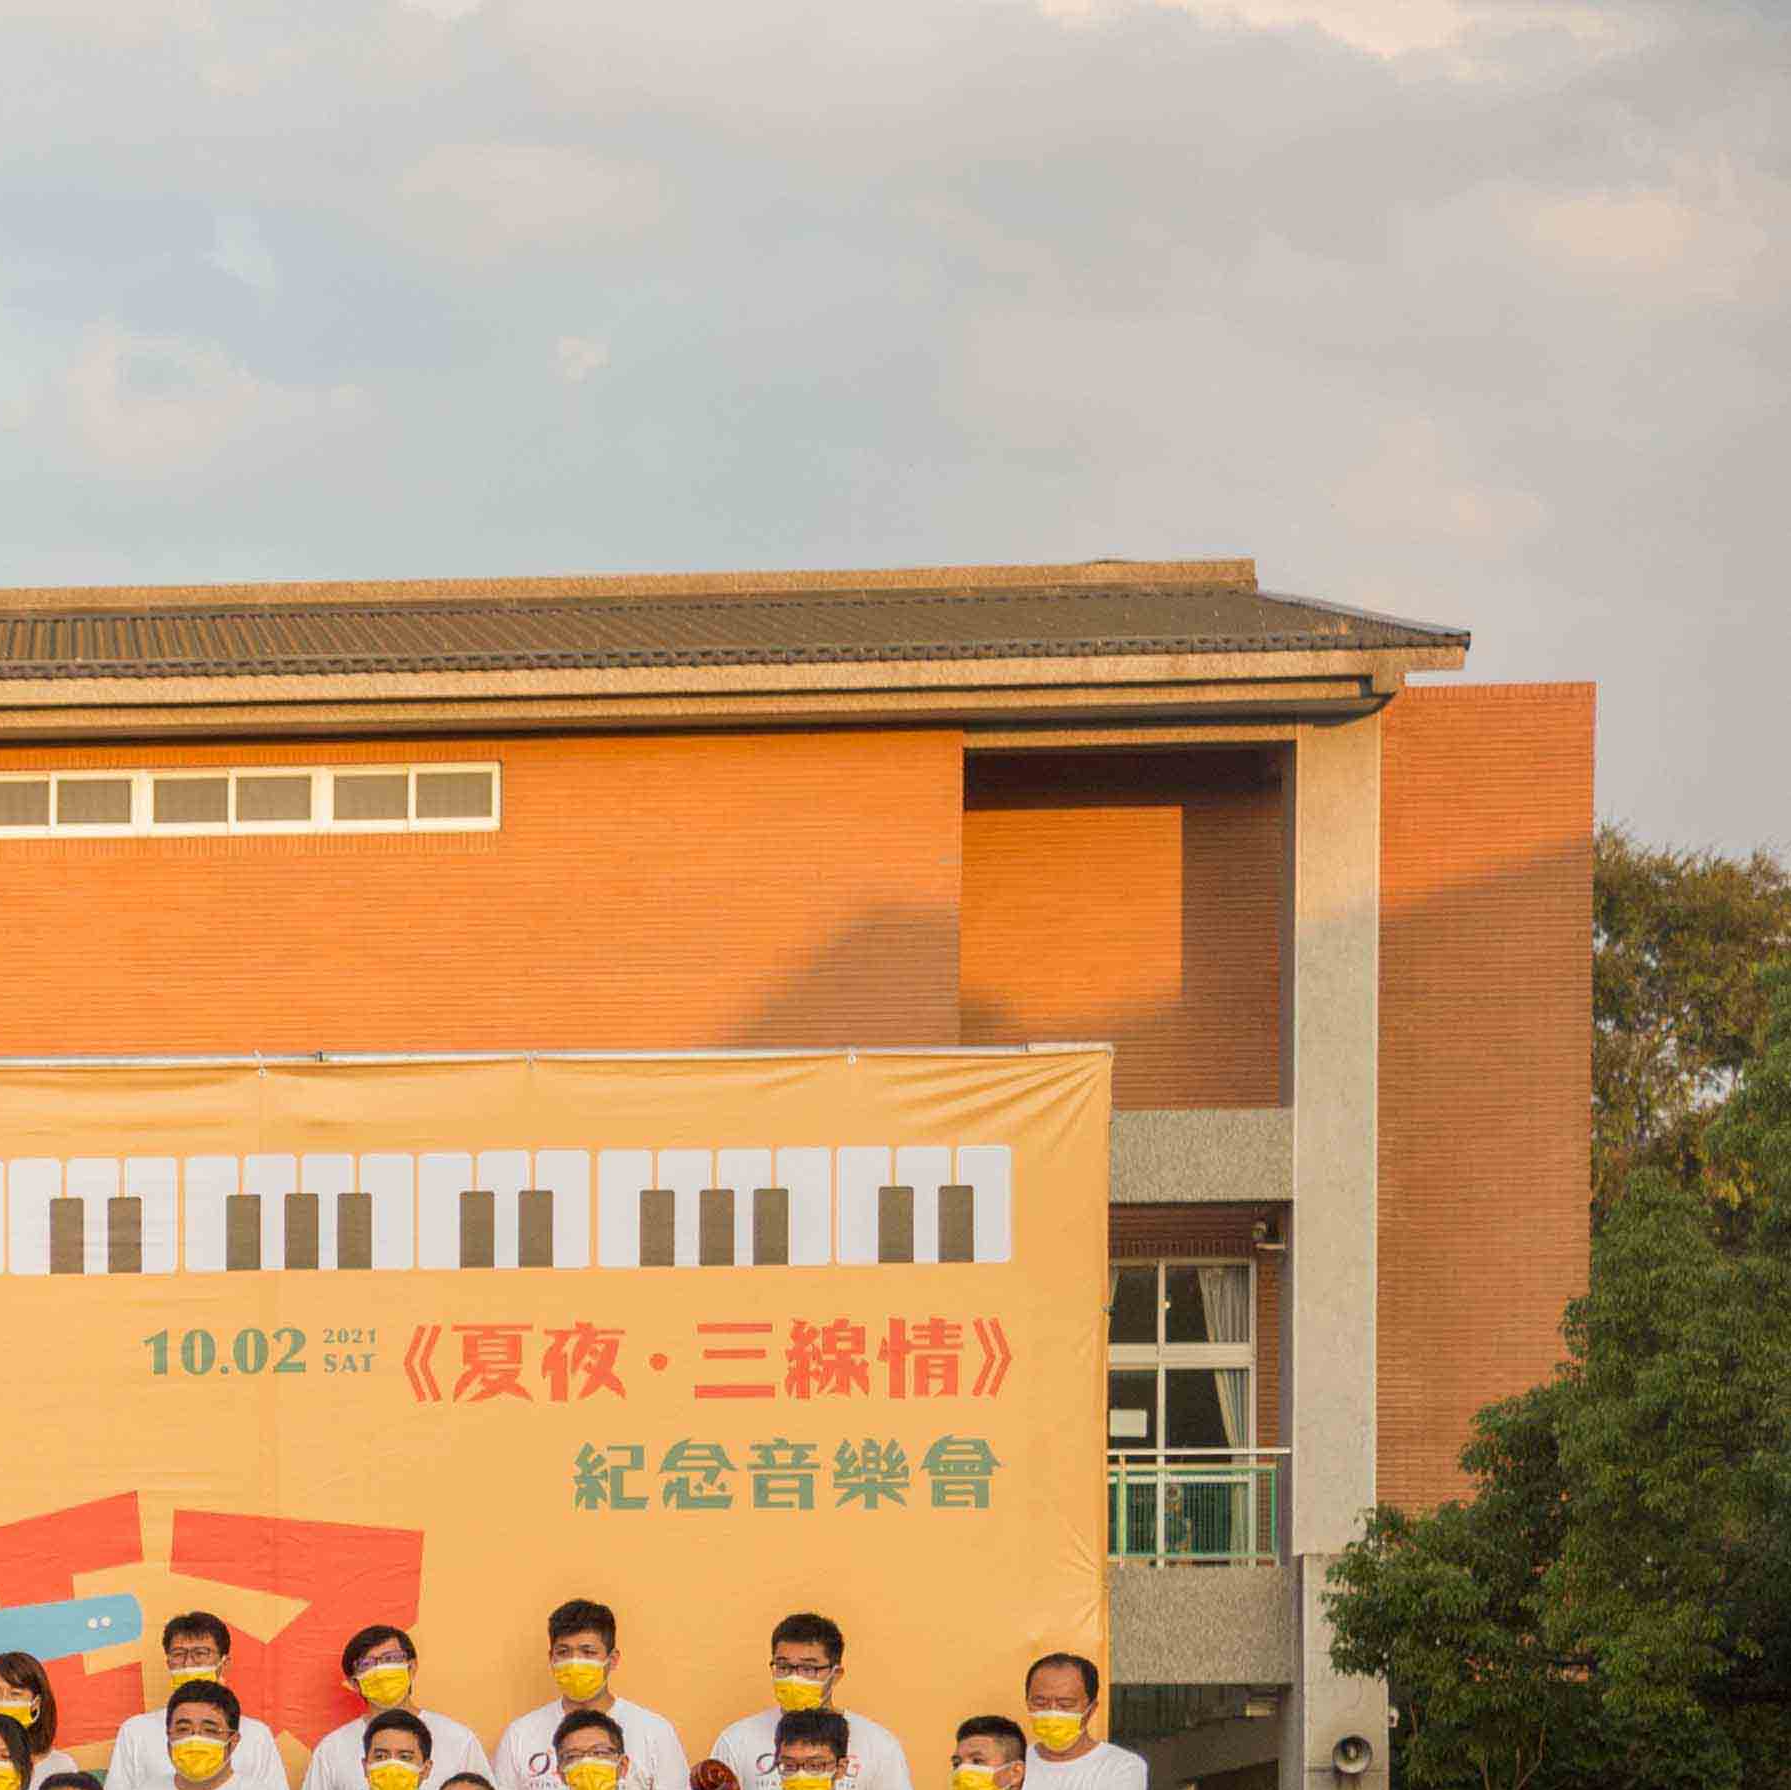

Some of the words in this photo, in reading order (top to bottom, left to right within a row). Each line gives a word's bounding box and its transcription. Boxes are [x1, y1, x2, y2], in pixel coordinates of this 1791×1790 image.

[143, 1327, 307, 1376] 10.02
[322, 1327, 379, 1345] 2021
[323, 1352, 378, 1374] SAT
[573, 1435, 1003, 1512] 紀念音樂會
